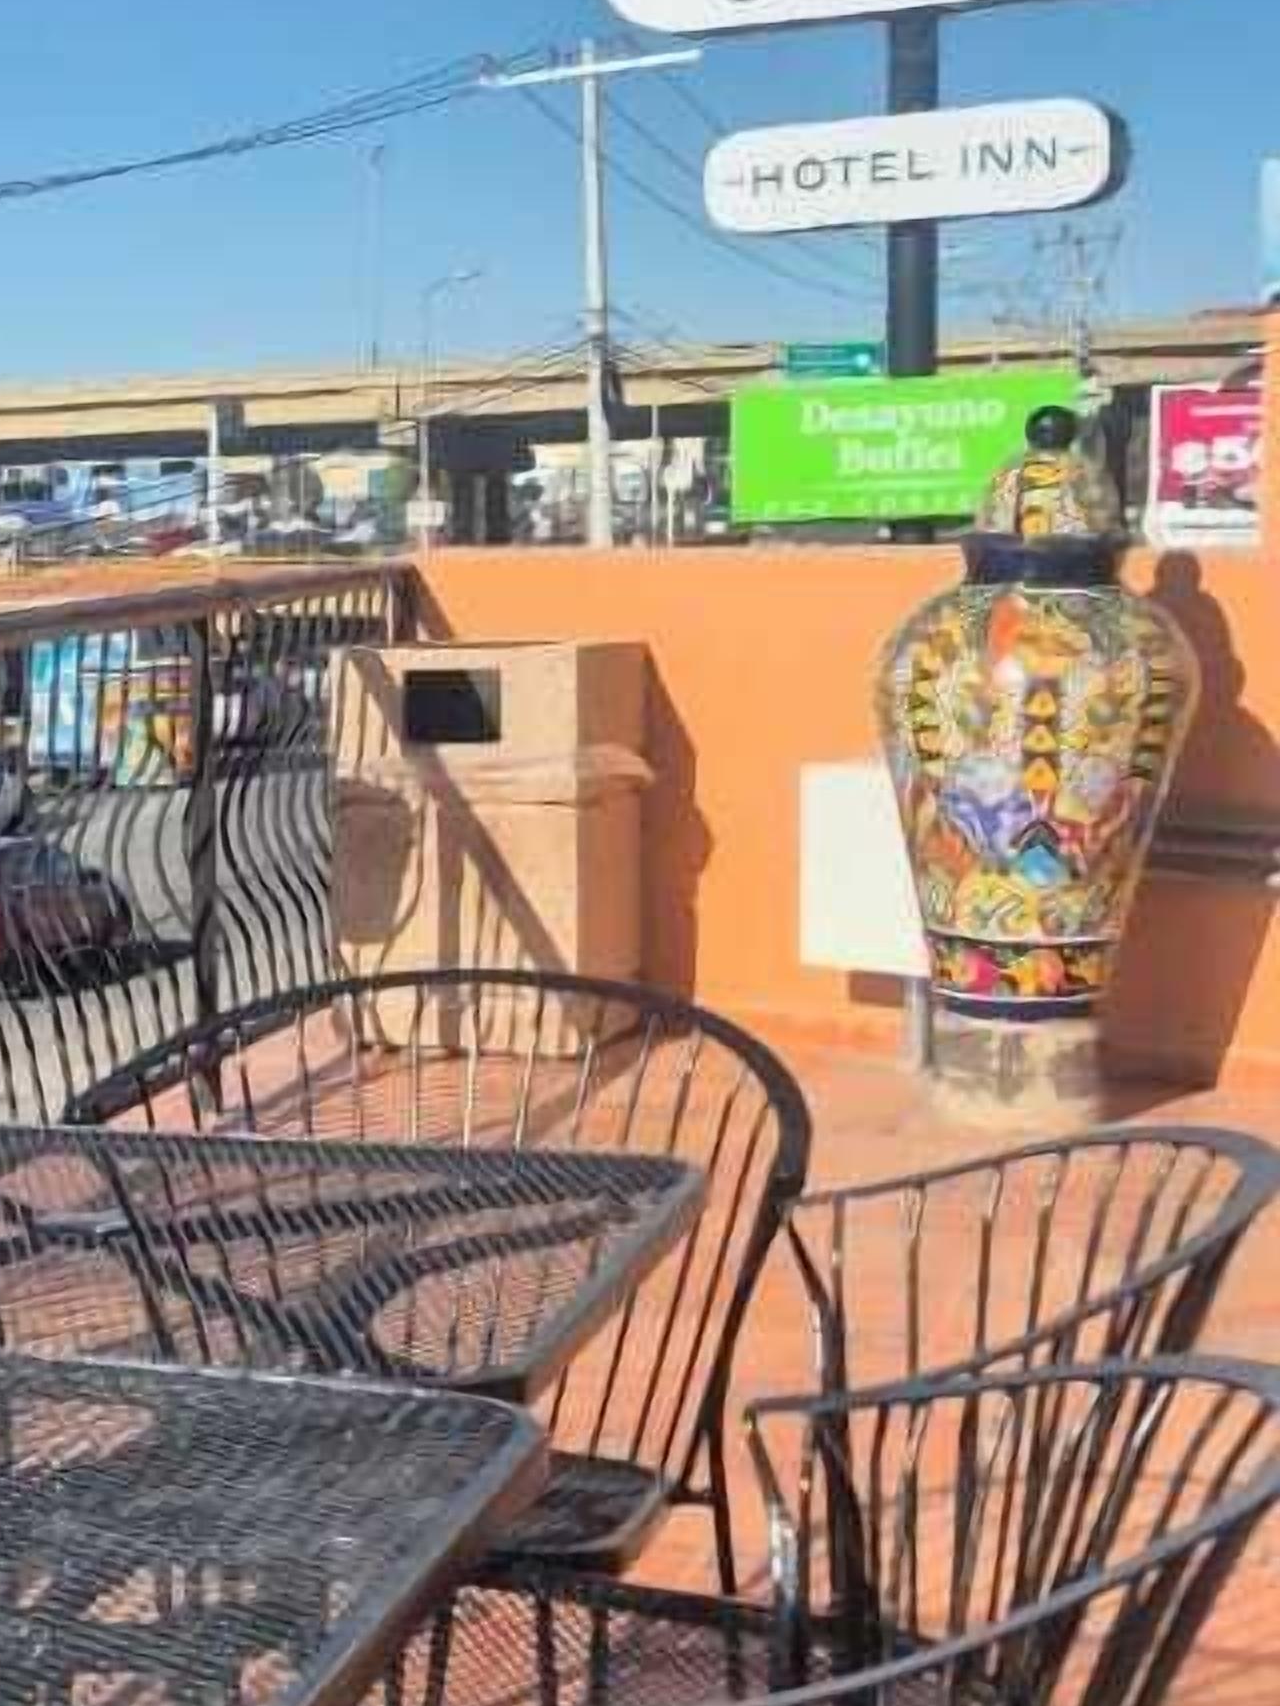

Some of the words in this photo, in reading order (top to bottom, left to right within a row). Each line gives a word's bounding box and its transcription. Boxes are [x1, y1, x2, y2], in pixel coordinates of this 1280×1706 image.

[750, 148, 932, 197] HOTEL
[958, 135, 1057, 178] INN
[800, 398, 1007, 437] Desayuno
